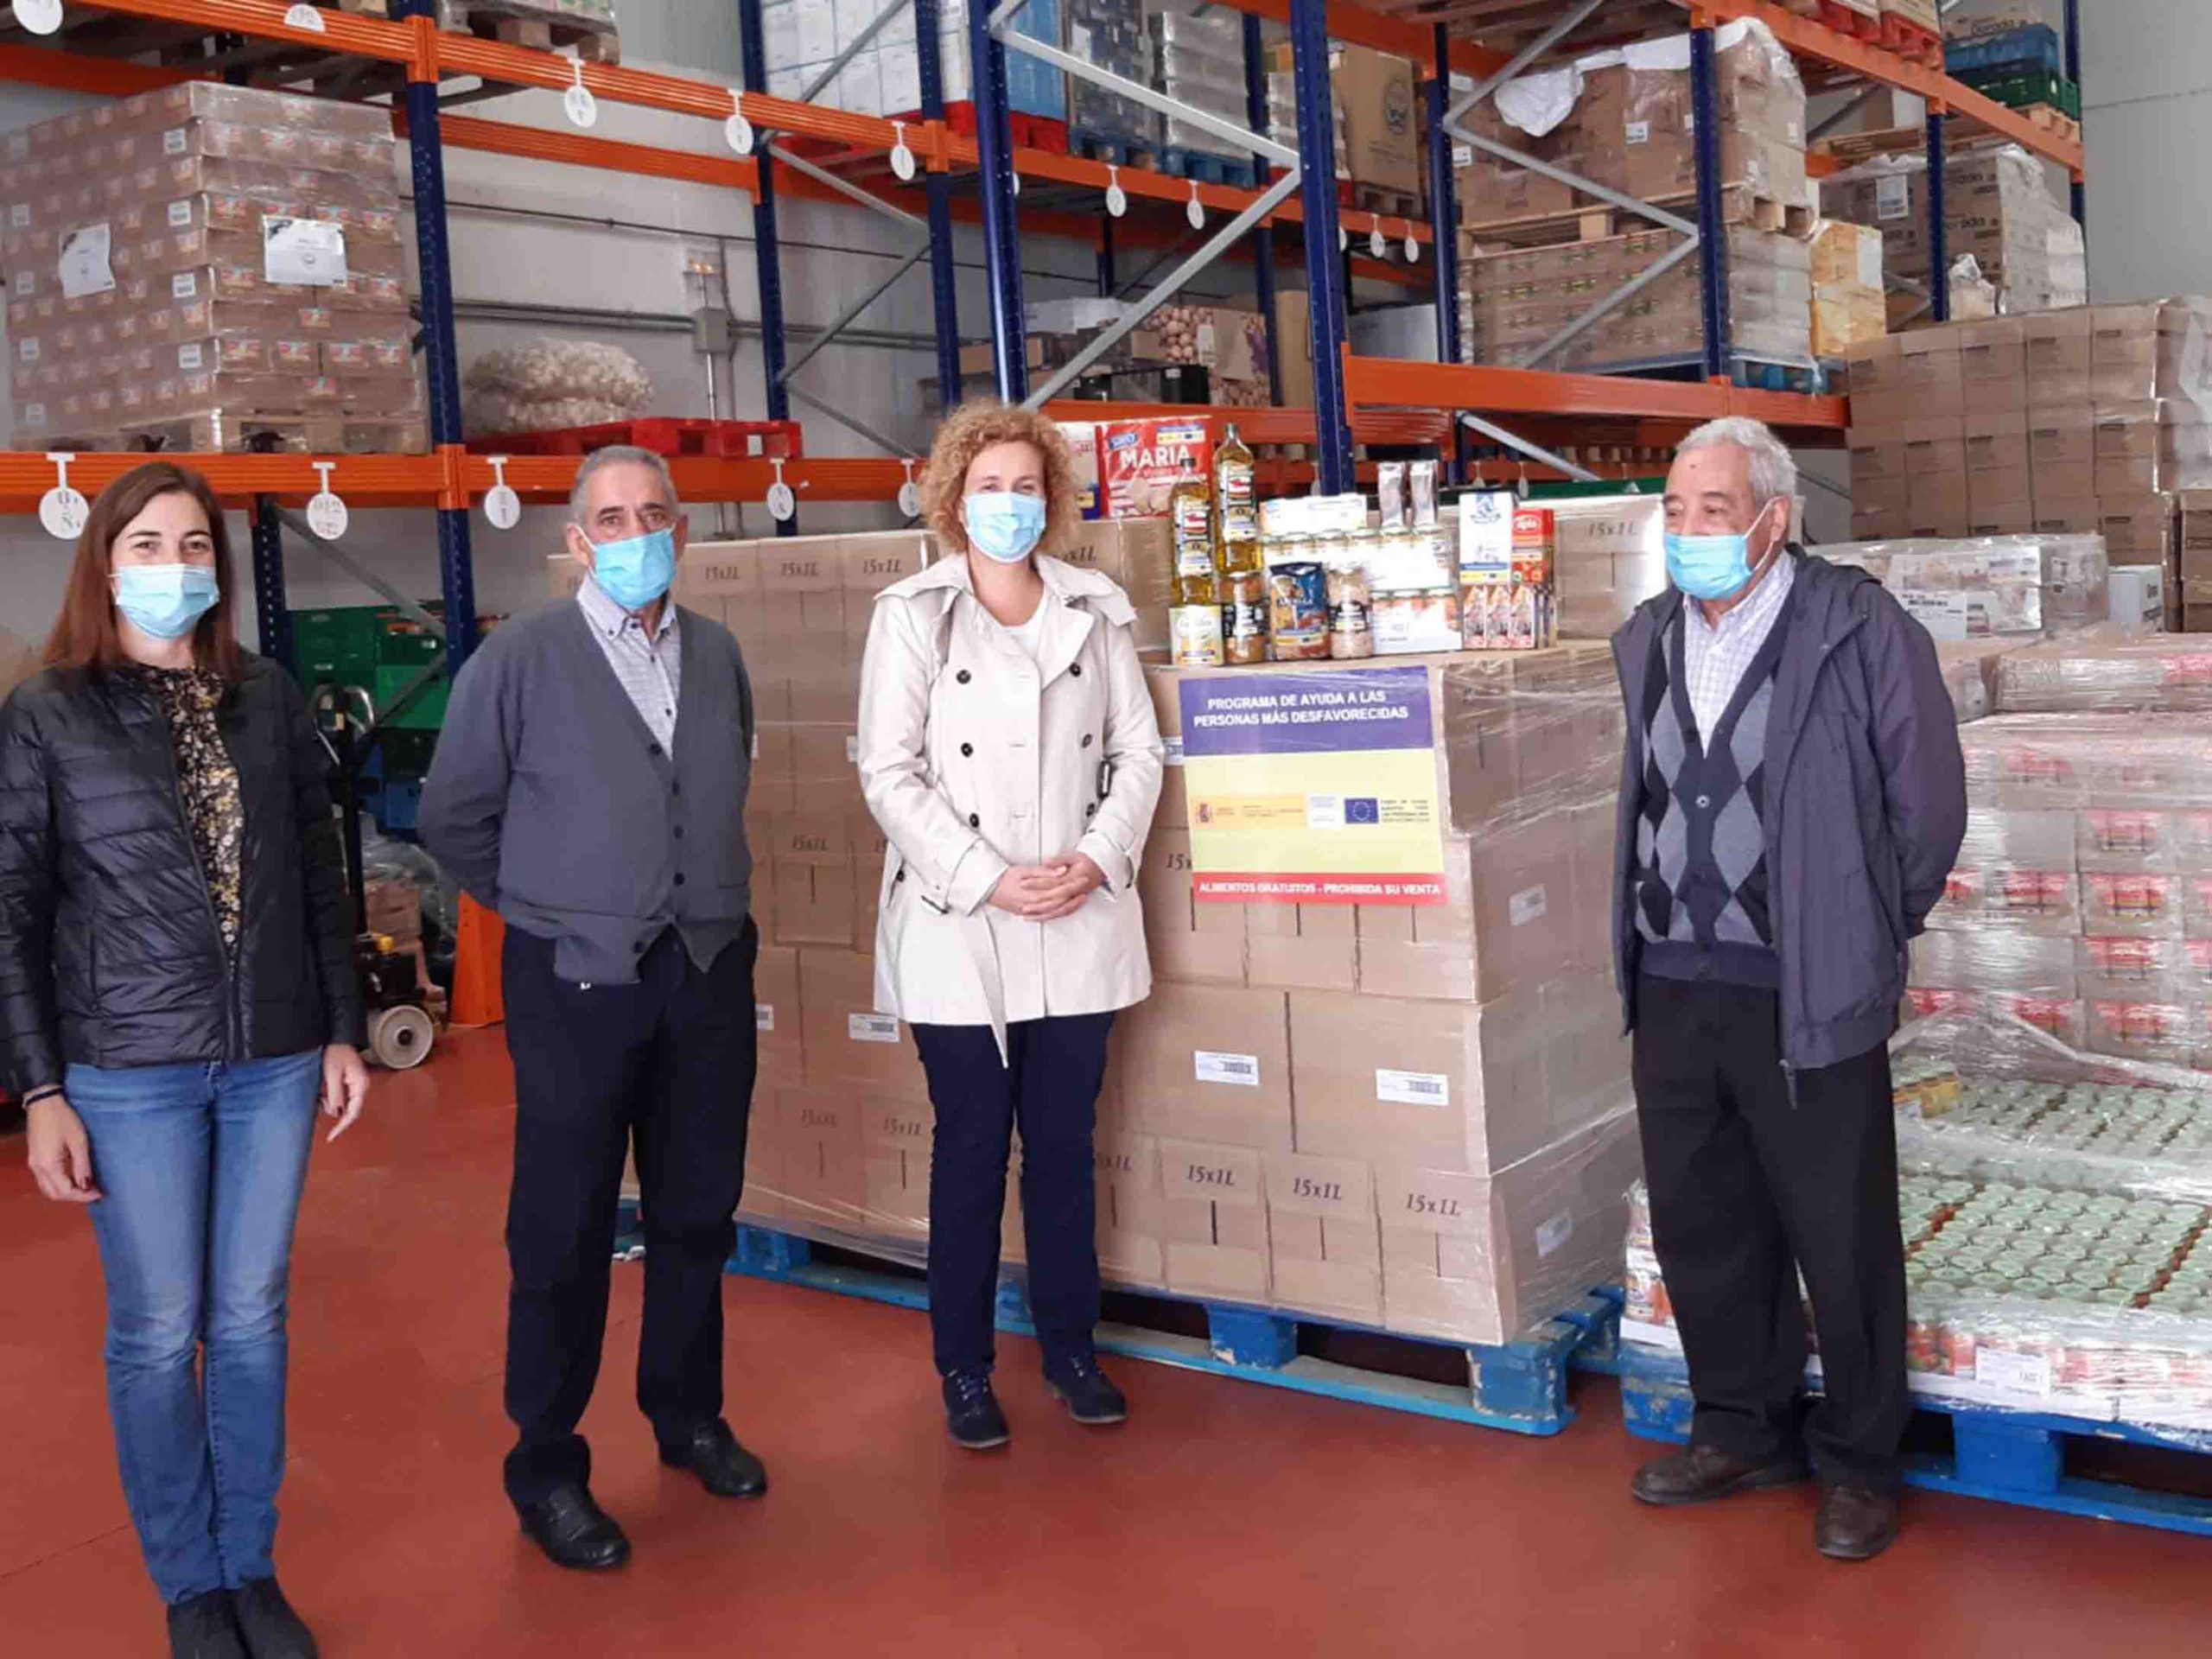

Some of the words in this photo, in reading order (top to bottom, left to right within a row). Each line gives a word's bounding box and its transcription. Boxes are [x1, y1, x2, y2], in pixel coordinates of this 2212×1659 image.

[1588, 520, 1637, 538] 15x1L
[1208, 696, 1278, 710] PROGRAMA
[1281, 693, 1299, 707] DE
[1300, 691, 1344, 706] AYUDA
[1346, 690, 1357, 704] A
[1359, 690, 1387, 703] LAS
[1194, 713, 1259, 728] PERSONAS
[1262, 709, 1289, 725] MÁS
[1292, 707, 1408, 723] DESFAVORECIDAS
[1198, 881, 1256, 894] ALIMENTOS
[1384, 883, 1401, 896] SU
[1402, 883, 1442, 896] VENTA
[1186, 1164, 1236, 1186] 15x1L
[1293, 1177, 1343, 1201] 15x1L
[1407, 1193, 1462, 1217] 15x1L
